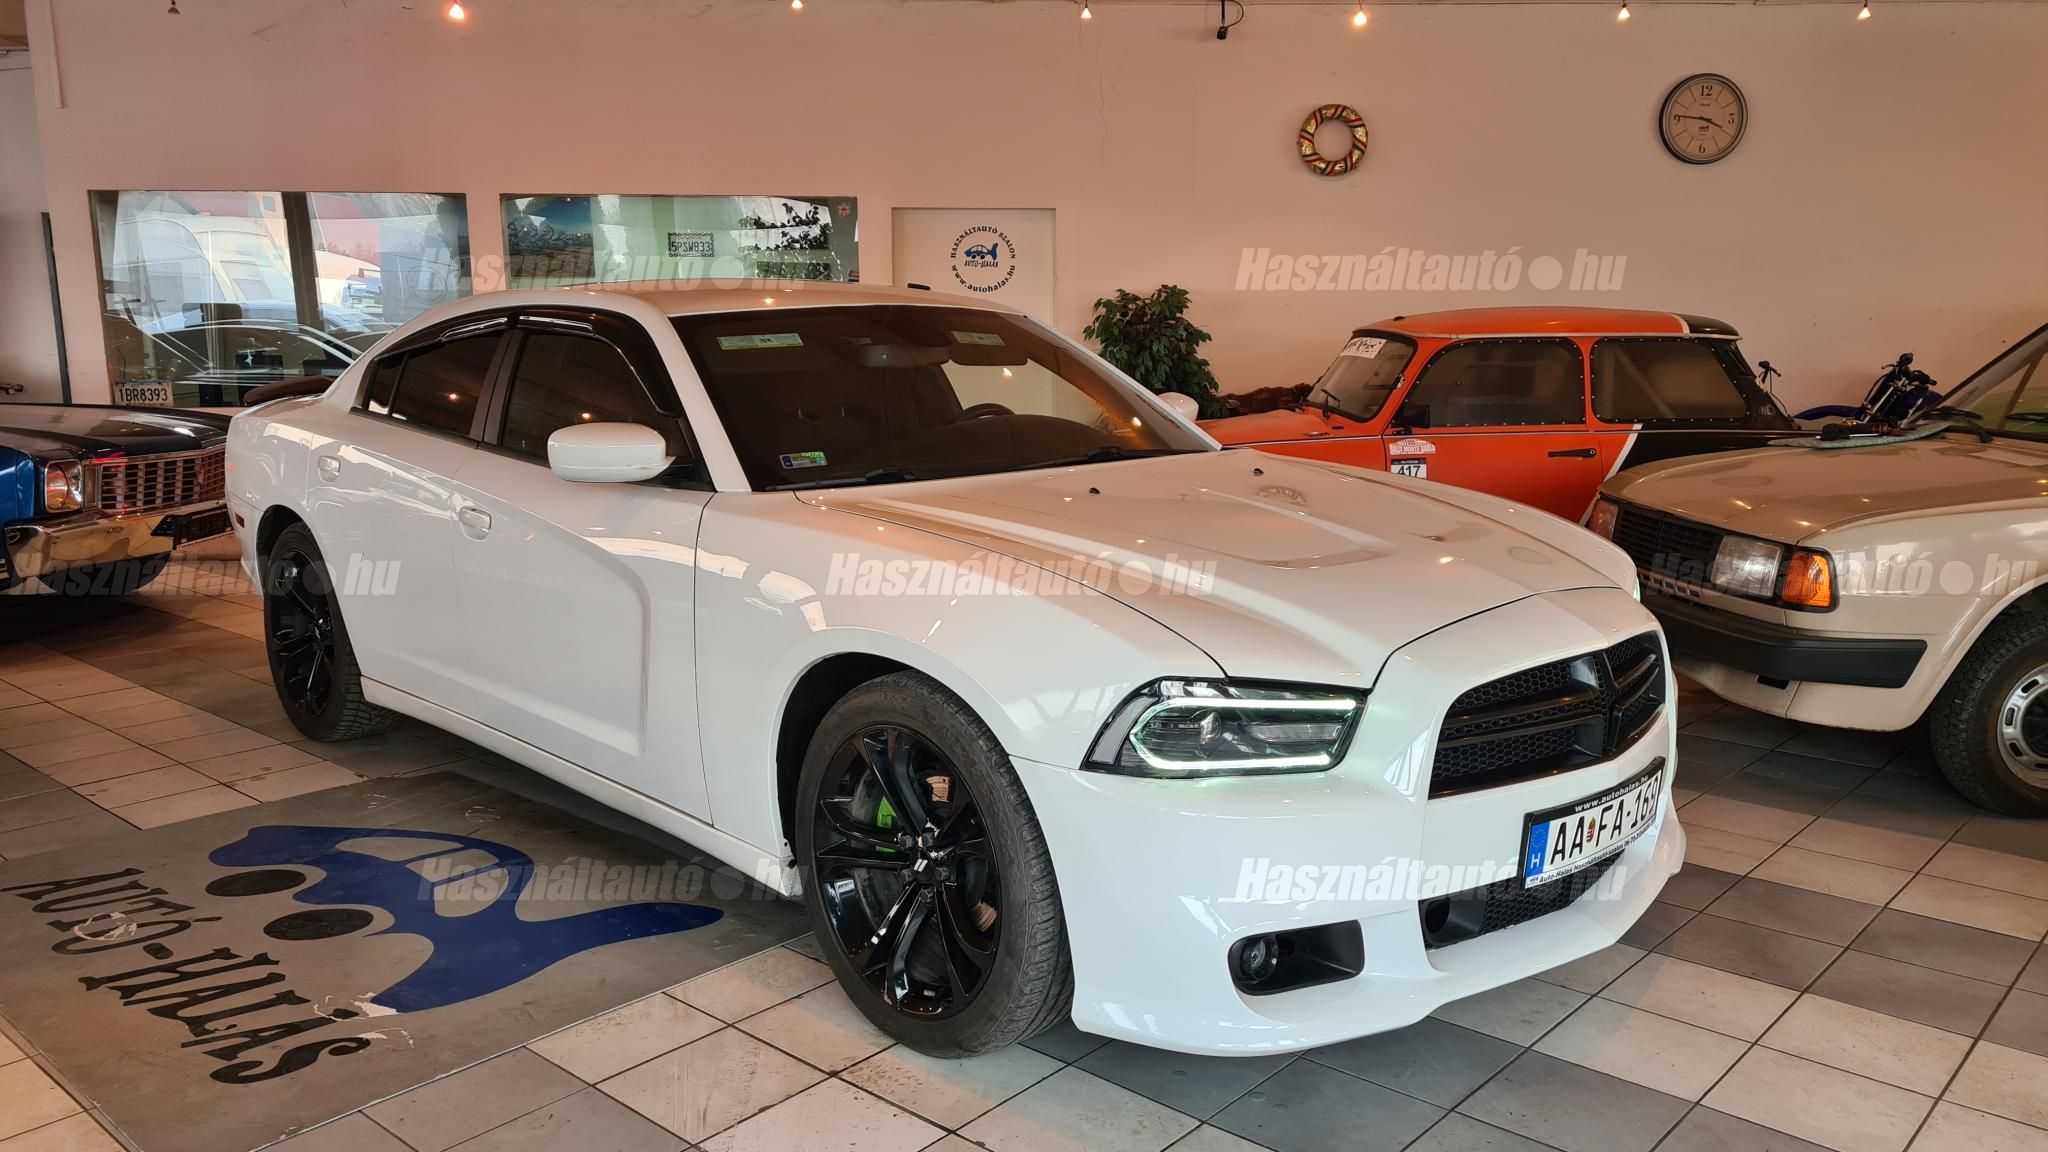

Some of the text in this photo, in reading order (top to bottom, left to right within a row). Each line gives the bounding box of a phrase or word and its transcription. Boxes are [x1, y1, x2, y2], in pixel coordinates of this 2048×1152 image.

[1700, 84, 1713, 97] 12
[1698, 143, 1706, 154] 6
[998, 232, 1016, 259] SZALON
[952, 264, 1015, 293] www.autohalas.hu
[119, 387, 168, 402] 1BR8393
[1398, 465, 1421, 478] 417
[1574, 774, 1649, 813] www.autohalas.hu
[1530, 852, 1541, 869] H
[1549, 815, 1585, 865] AA
